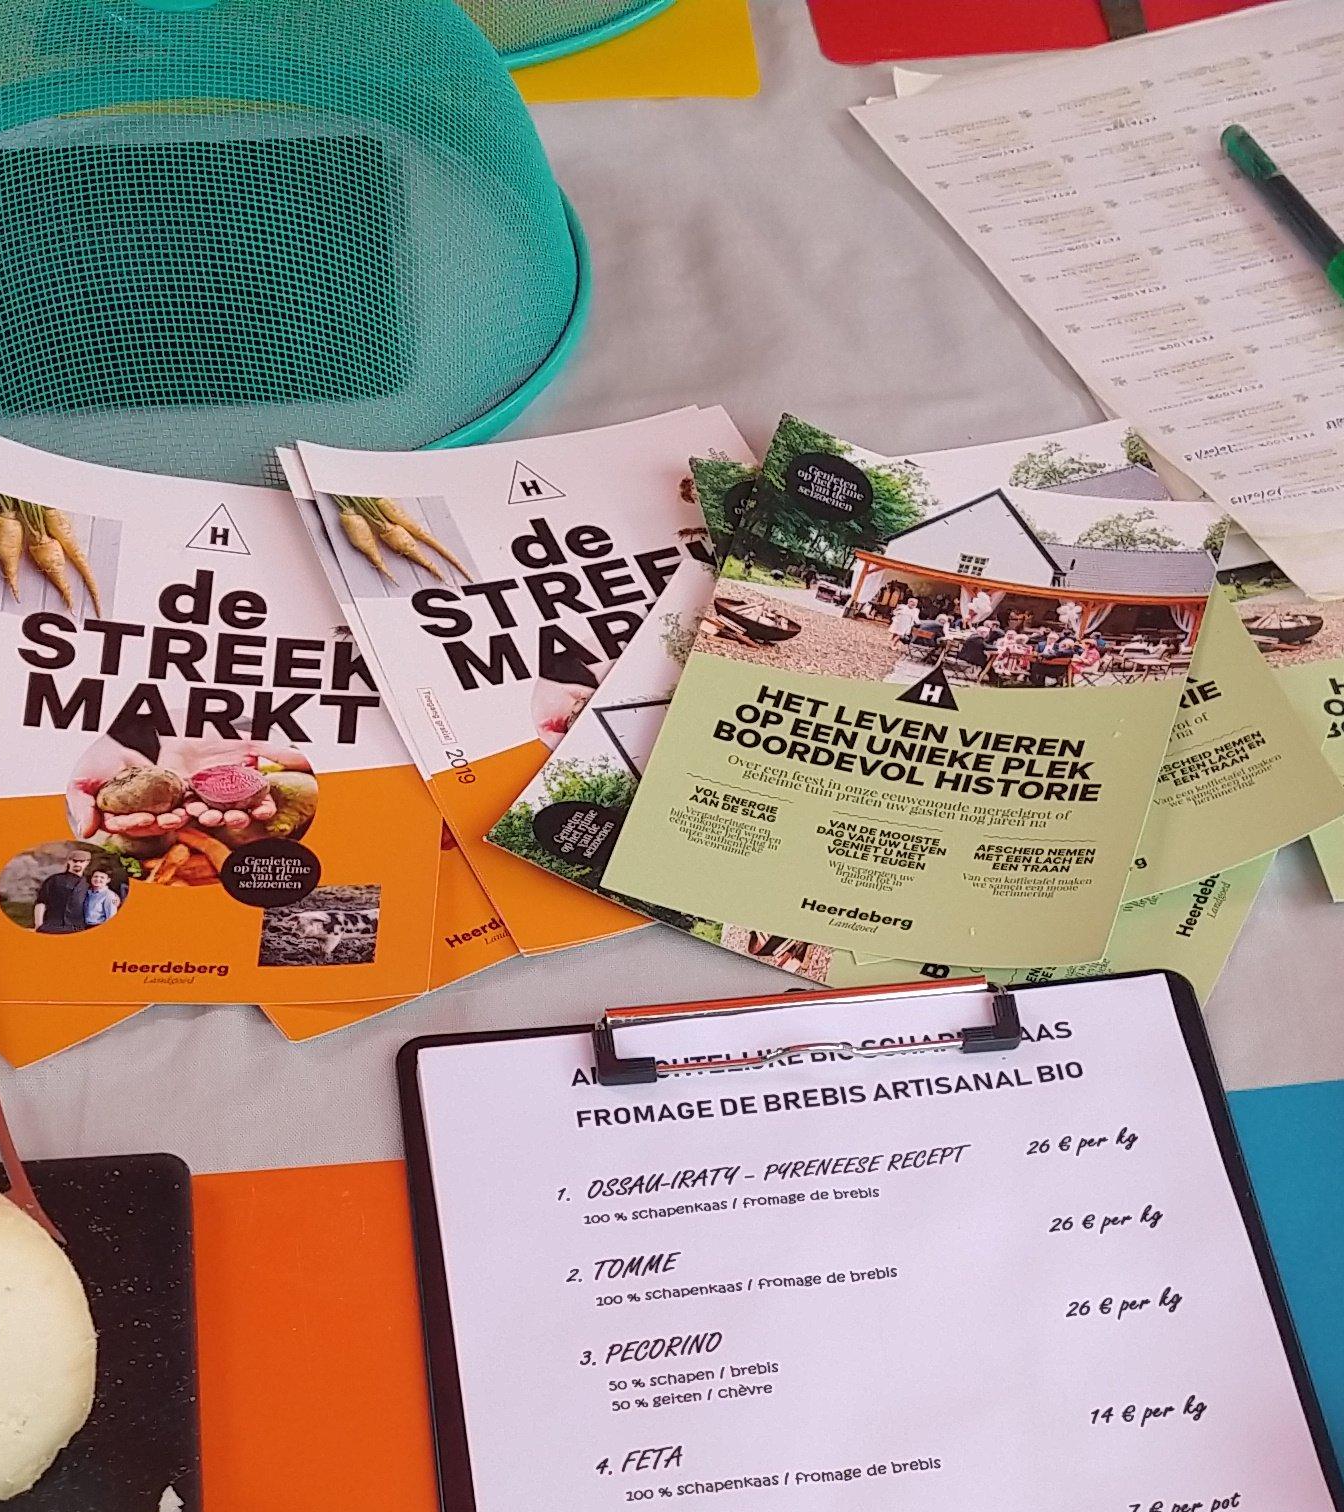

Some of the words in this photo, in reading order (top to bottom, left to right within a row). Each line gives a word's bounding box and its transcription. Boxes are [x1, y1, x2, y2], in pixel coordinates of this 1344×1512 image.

[519, 479, 543, 497] H
[209, 527, 230, 547] H
[510, 517, 614, 569] de
[158, 569, 268, 629] de
[17, 611, 381, 693] STREEK
[22, 672, 380, 745] MARKT
[919, 683, 944, 703] H
[757, 685, 828, 718] HET
[834, 704, 949, 743] LEVEN
[959, 730, 1085, 757] VIEREN
[735, 704, 784, 729] OP
[791, 718, 858, 750] EEN
[865, 732, 994, 773] UNIEKE
[1002, 756, 1096, 780] PLEK
[446, 748, 476, 784] 2019
[713, 719, 926, 787] BOORDEVOL
[934, 770, 1103, 802] HISTORIE
[688, 794, 721, 812] AAN
[722, 802, 740, 816] DE
[741, 806, 777, 824] SLAG
[694, 785, 720, 800] VOL
[723, 792, 779, 815] ENERGIE
[973, 853, 1003, 862] MET
[1005, 854, 1034, 863] EEN
[1035, 856, 1072, 864] LACH
[976, 844, 1046, 856] AFSCHEID
[1047, 848, 1096, 856] NEMEN
[992, 863, 1019, 871] EEN
[1022, 864, 1071, 873] TRAAN
[801, 898, 913, 930] Heerdeberg
[112, 959, 229, 977] Heerdeberg
[577, 1100, 714, 1128] FROMAGE
[720, 1096, 757, 1116] DE
[763, 1086, 866, 1112] BREBIS
[873, 1069, 1032, 1101] ARTISANAL
[1037, 1062, 1083, 1083] BIO
[1026, 1139, 1050, 1155] 26
[1076, 1137, 1108, 1156] per
[1116, 1127, 1138, 1150] kg
[558, 1188, 570, 1201] 1.
[588, 1166, 741, 1199] OSSAU-IRATY
[764, 1155, 884, 1181] PYRENEESE
[887, 1144, 971, 1171] RECEPT
[584, 1214, 610, 1224] 100
[632, 1201, 727, 1220] schapenkaas
[743, 1193, 805, 1208] fromage
[810, 1190, 829, 1200] de
[833, 1188, 879, 1199] brebis
[566, 1269, 582, 1282] 2.
[595, 1252, 681, 1280] TOMME
[580, 1351, 596, 1366] 3.
[605, 1332, 722, 1364] PECORINO
[609, 1381, 627, 1391] 50
[650, 1371, 714, 1386] schapen
[730, 1362, 778, 1377] brebis
[596, 1458, 612, 1475] 4.
[622, 1446, 683, 1472] FETA
